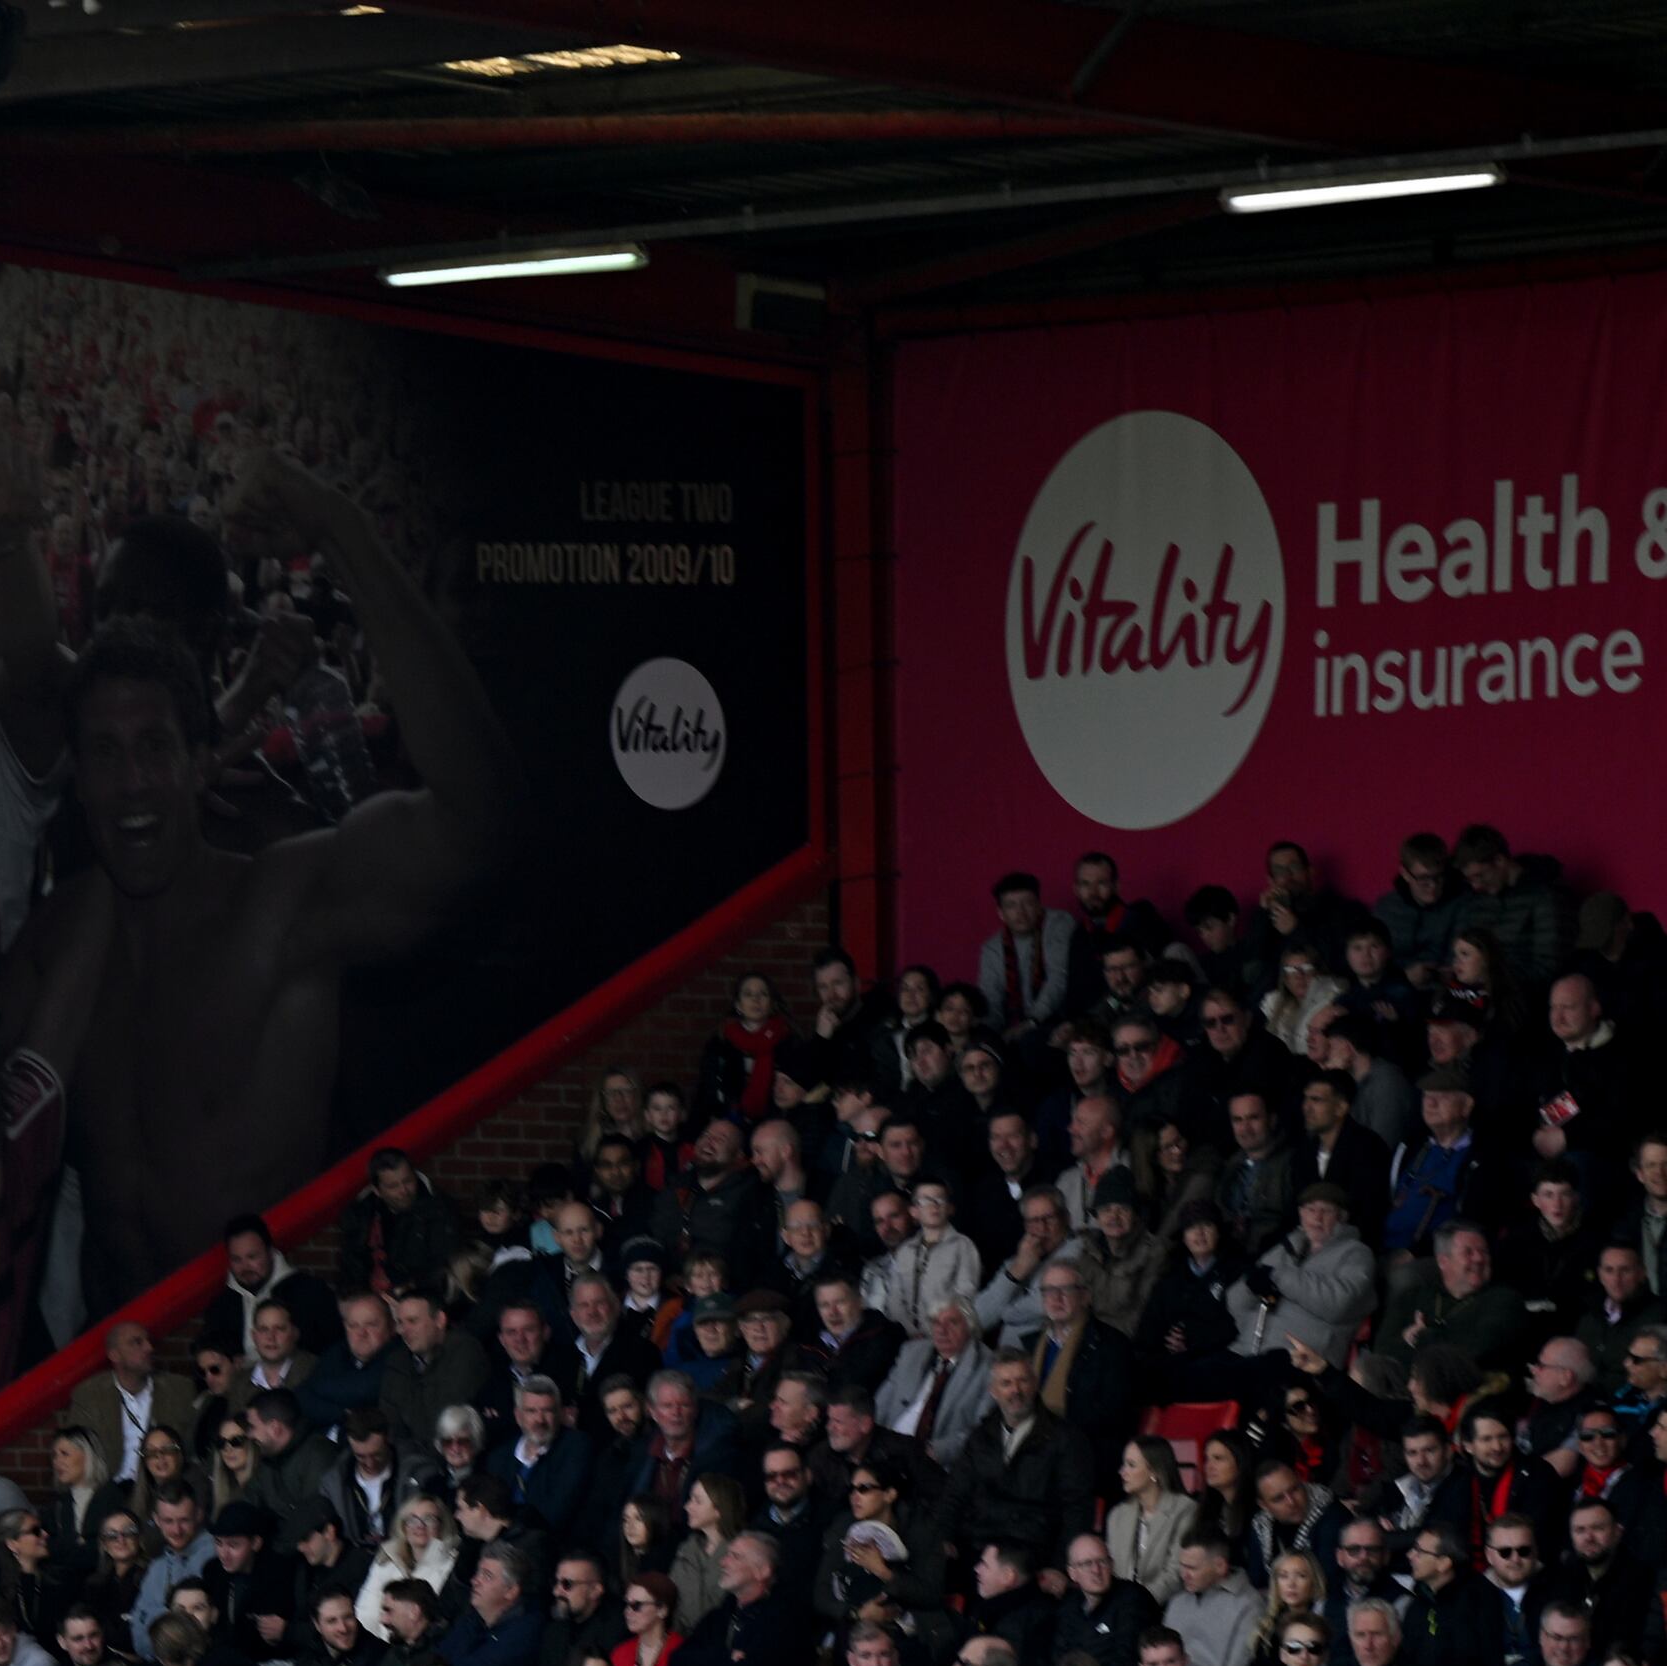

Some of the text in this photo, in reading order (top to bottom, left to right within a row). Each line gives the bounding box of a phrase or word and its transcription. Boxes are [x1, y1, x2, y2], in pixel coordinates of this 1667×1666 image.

[578, 480, 734, 525] LEAGUE TWO
[1316, 473, 1609, 608] Health
[475, 541, 736, 587] PROMOTION 2009/10
[1023, 519, 1272, 718] Vitality
[1313, 628, 1644, 718] insurance
[617, 695, 724, 773] Vitality
